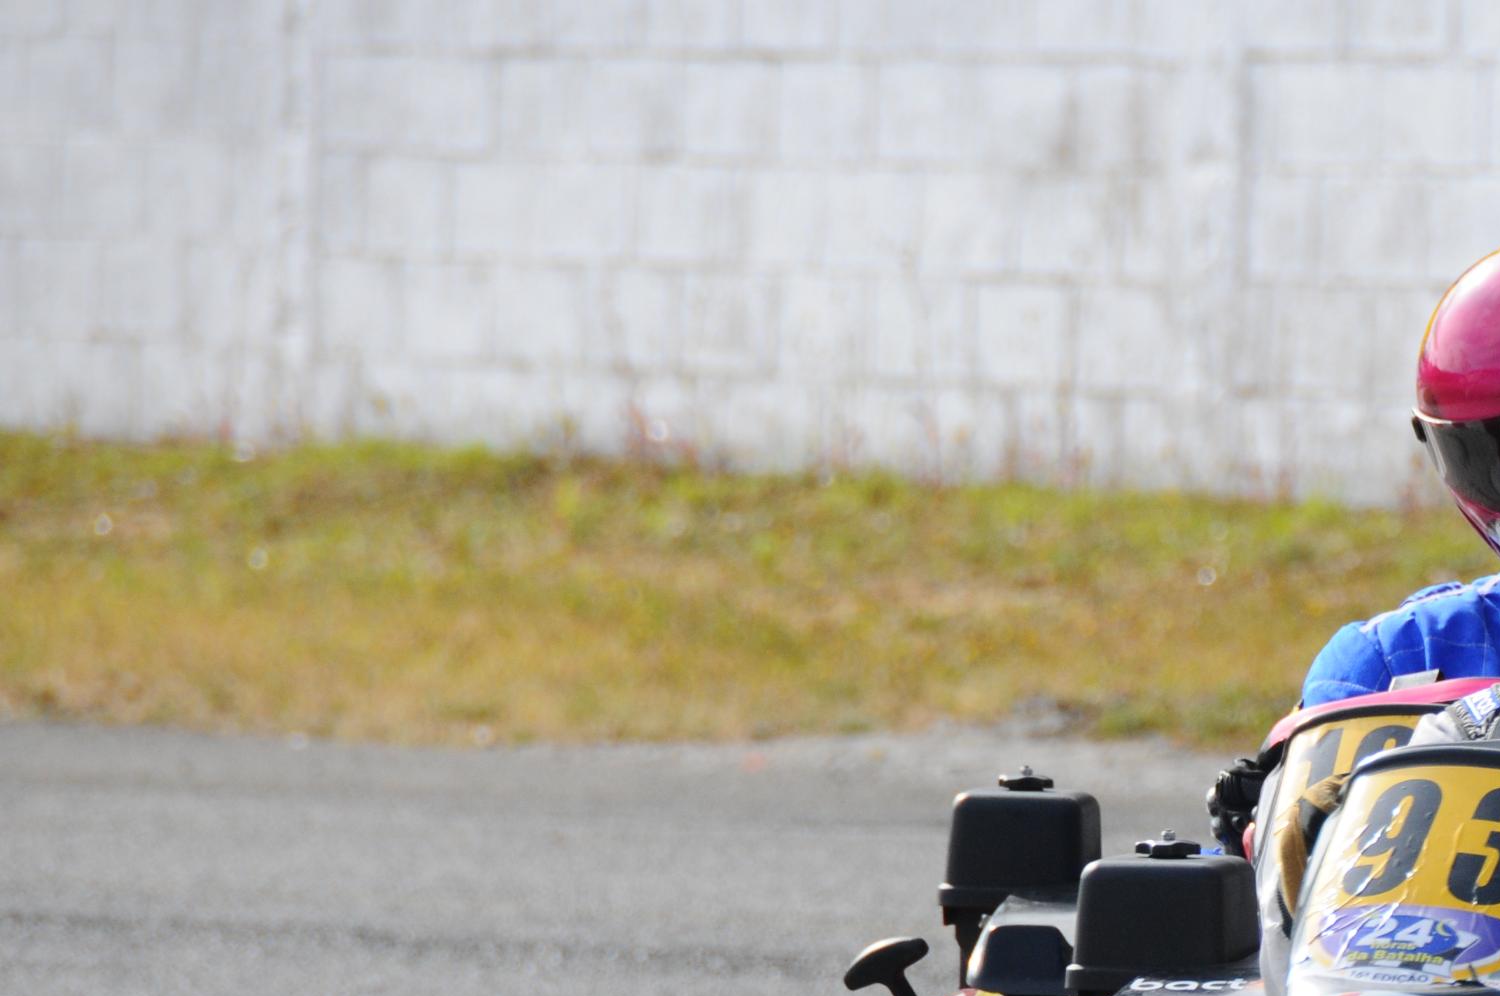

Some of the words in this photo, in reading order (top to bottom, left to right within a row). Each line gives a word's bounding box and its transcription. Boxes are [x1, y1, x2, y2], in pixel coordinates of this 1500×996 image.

[1355, 917, 1434, 948] 24
[1346, 950, 1369, 962] da
[1373, 949, 1445, 966] Batalha
